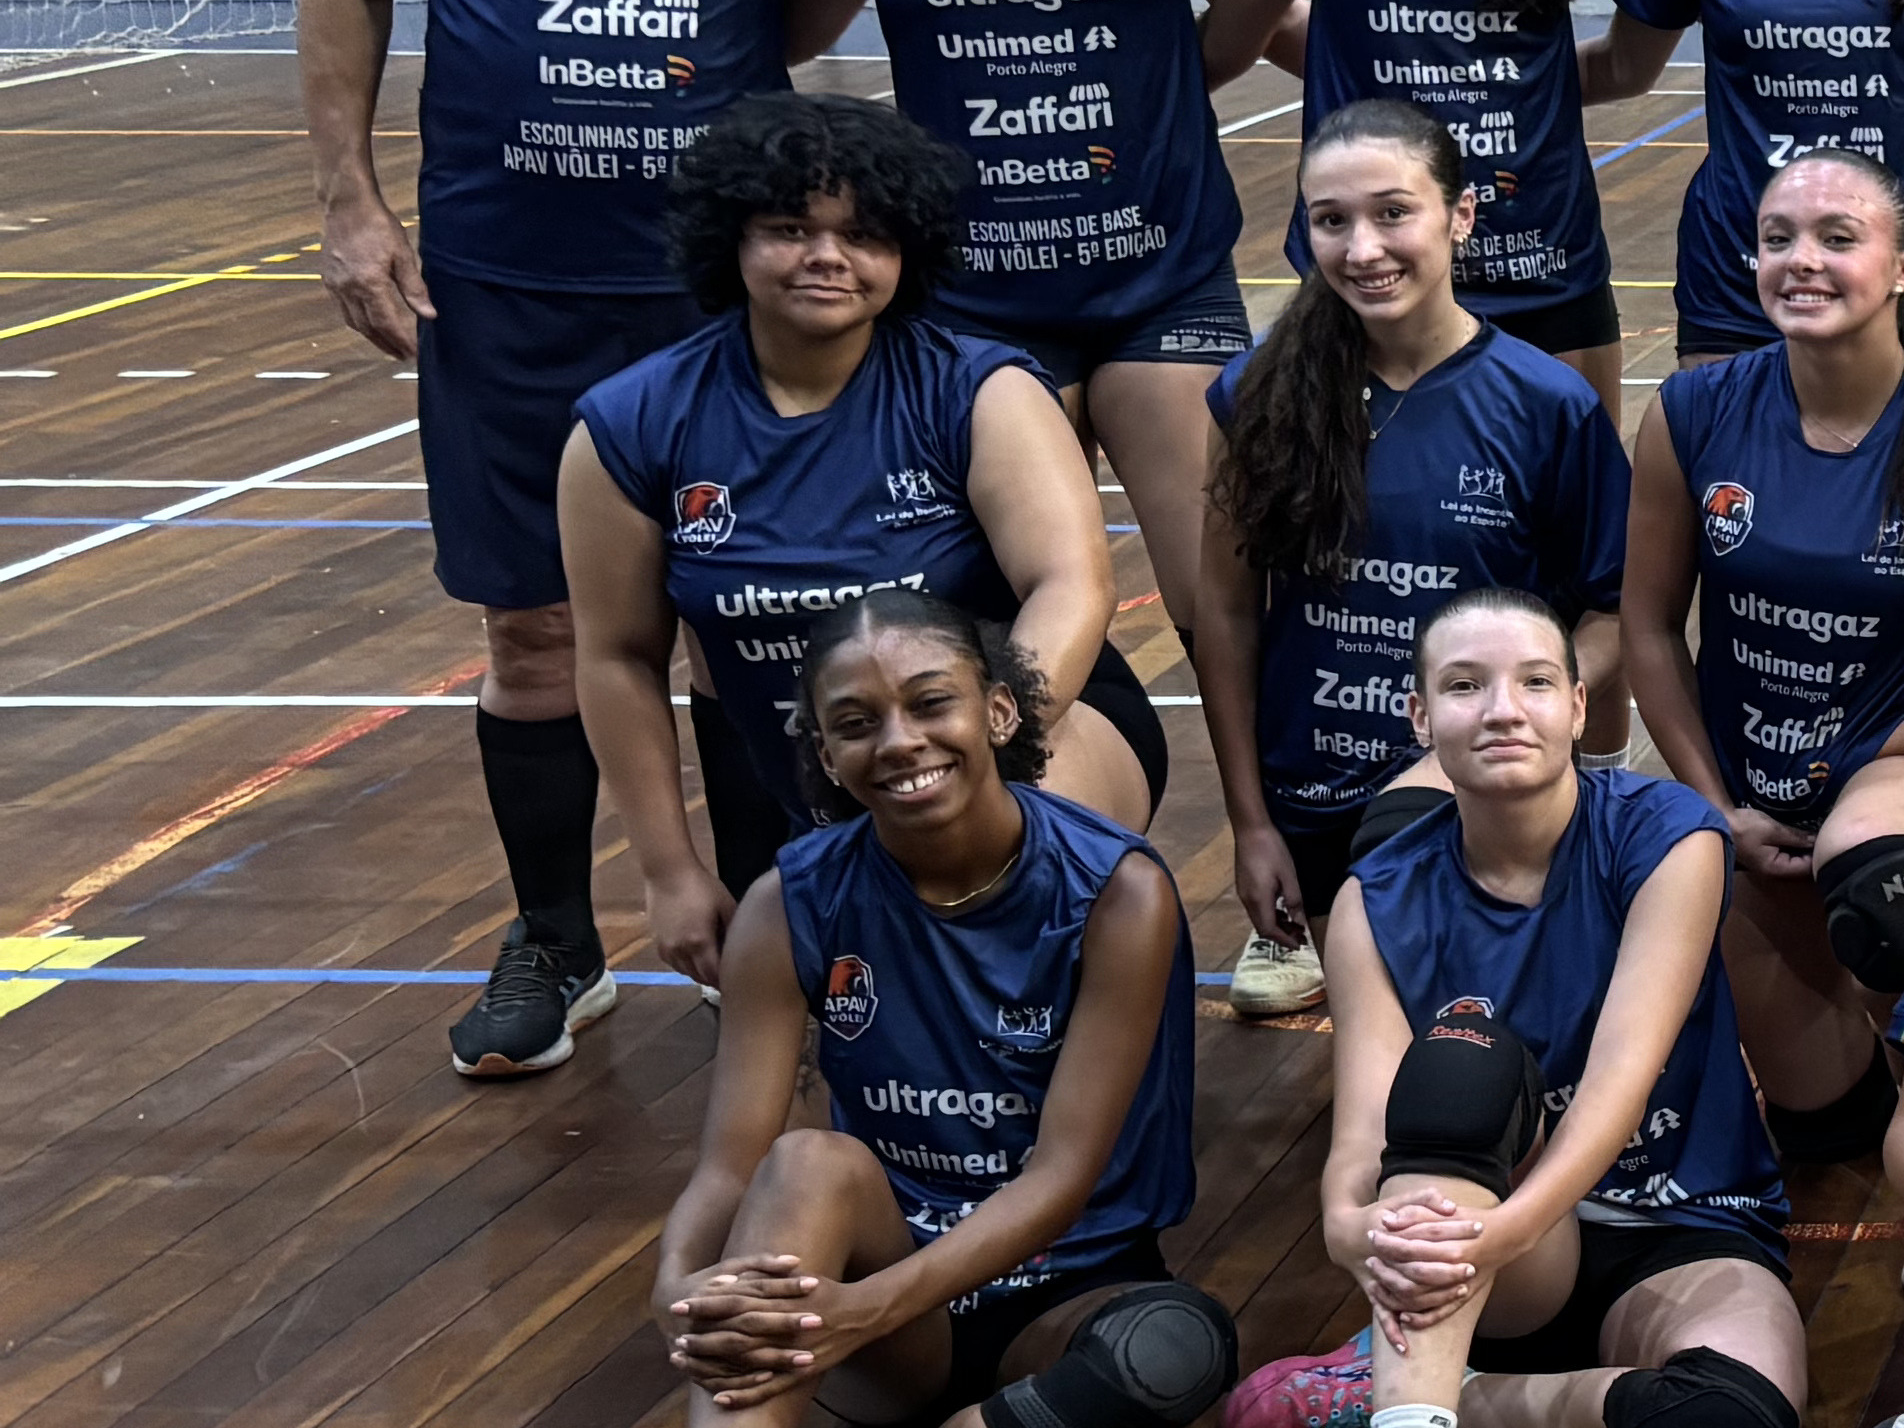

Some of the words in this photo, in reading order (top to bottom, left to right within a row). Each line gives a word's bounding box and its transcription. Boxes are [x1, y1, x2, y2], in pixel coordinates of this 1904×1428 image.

[1368, 2, 1518, 43] ultragaz
[938, 29, 1074, 58] Unimed
[1744, 20, 1892, 58] ultragaz
[539, 56, 666, 90] InBetta
[987, 62, 1027, 76] Porto
[1030, 60, 1077, 76] Alegre
[1373, 59, 1486, 84] Unimed
[1412, 91, 1445, 103] Porto
[1447, 90, 1488, 104] Alegre
[1753, 74, 1858, 97] Unimed
[964, 83, 1113, 136] Zaffari
[1788, 103, 1818, 115] Porto
[1821, 103, 1858, 118] Alegre
[520, 120, 638, 149] ESCOLINHAS
[644, 128, 668, 150] DE
[504, 143, 548, 174] APAV
[978, 159, 1090, 186] InBetta
[969, 216, 1072, 242] ESCOLINHAS
[1076, 214, 1099, 236] DE
[1102, 206, 1142, 231] BASE
[1305, 603, 1415, 640] Unimed
[1729, 593, 1880, 643] ultragaz
[1336, 639, 1371, 653] Porto
[1374, 642, 1412, 661] Alegre
[1733, 638, 1833, 684] Unimed
[1761, 678, 1790, 695] Porto
[1792, 686, 1829, 703] Alegre
[825, 996, 868, 1012] APAV
